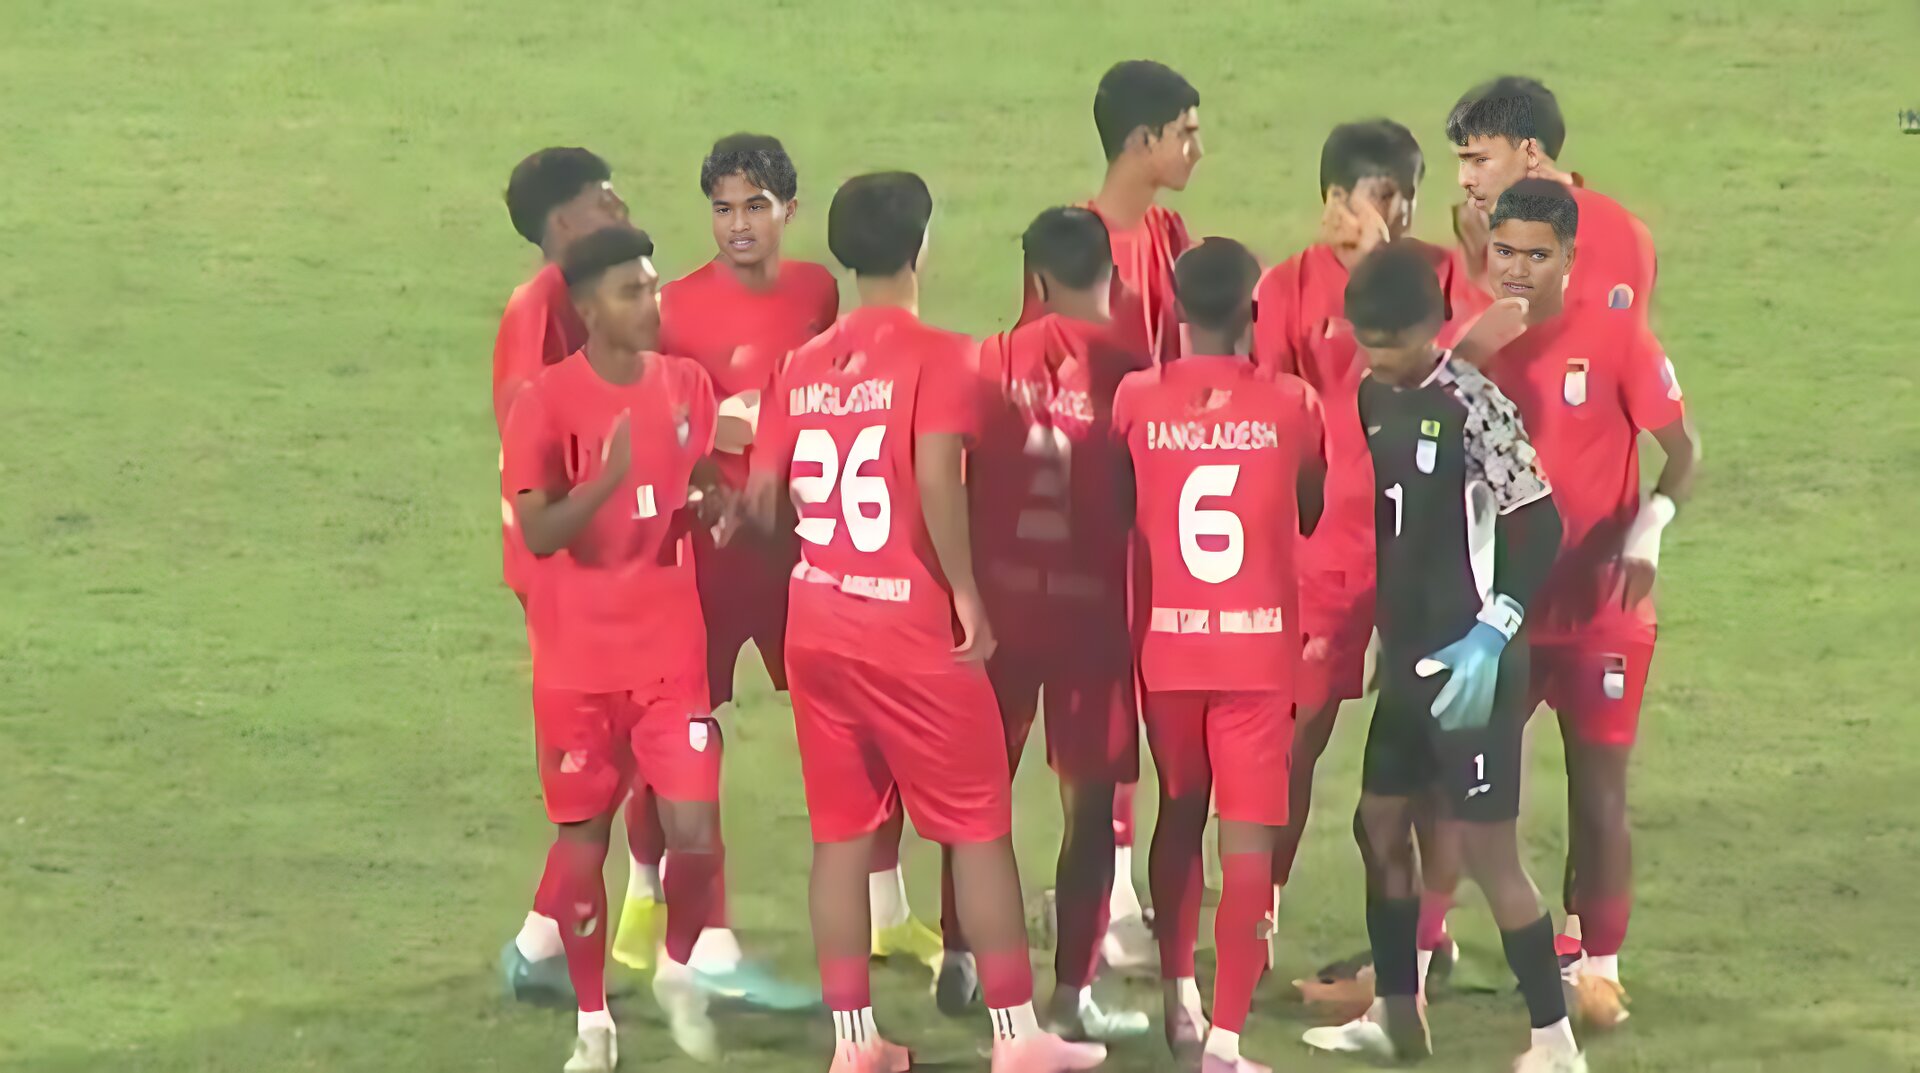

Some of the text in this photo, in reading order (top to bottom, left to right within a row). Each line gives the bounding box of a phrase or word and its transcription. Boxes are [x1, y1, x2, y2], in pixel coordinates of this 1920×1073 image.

[790, 425, 890, 552] 26
[1178, 464, 1244, 584] 6
[1384, 482, 1403, 538] 1
[1473, 753, 1485, 781] 1
